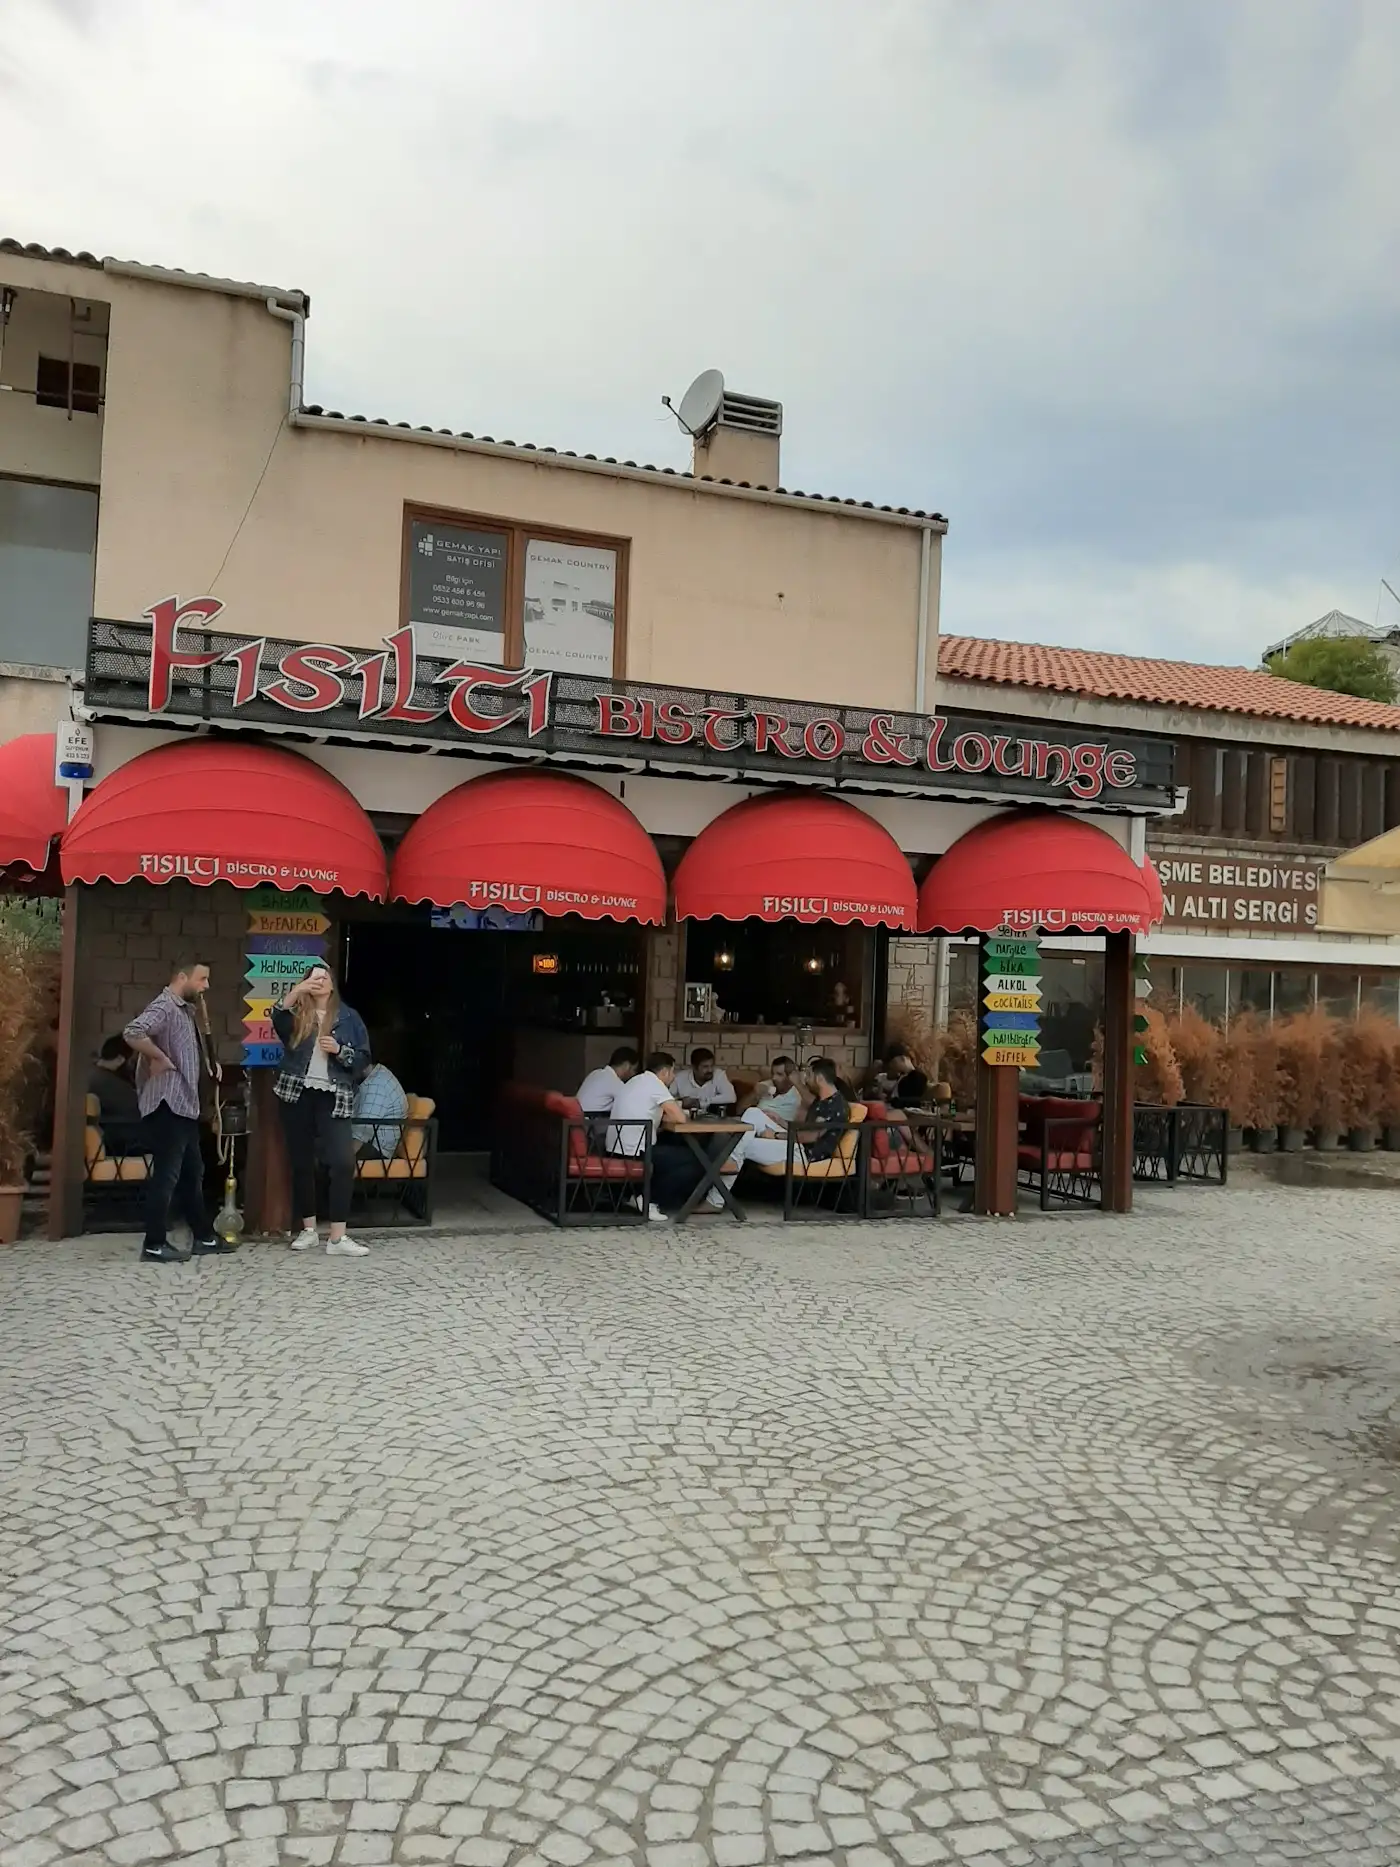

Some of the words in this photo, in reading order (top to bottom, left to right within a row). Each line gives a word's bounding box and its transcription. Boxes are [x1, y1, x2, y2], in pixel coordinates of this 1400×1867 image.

[436, 540, 475, 552] GEMAK
[478, 546, 502, 556] YAPI
[530, 554, 563, 565] GEMAK
[566, 559, 611, 571] COUNTRY
[528, 646, 561, 656] GEMAK
[565, 651, 610, 663] COUNTRY
[68, 737, 87, 745] EFE
[861, 713, 919, 768] &
[280, 866, 291, 877] &
[293, 867, 340, 882] LOUNGE
[590, 893, 600, 904] &
[869, 904, 877, 914] &
[1182, 895, 1228, 920] ALTI
[1234, 898, 1299, 924] SERGİ
[1107, 913, 1115, 923] &
[997, 979, 1027, 991] ALKOL
